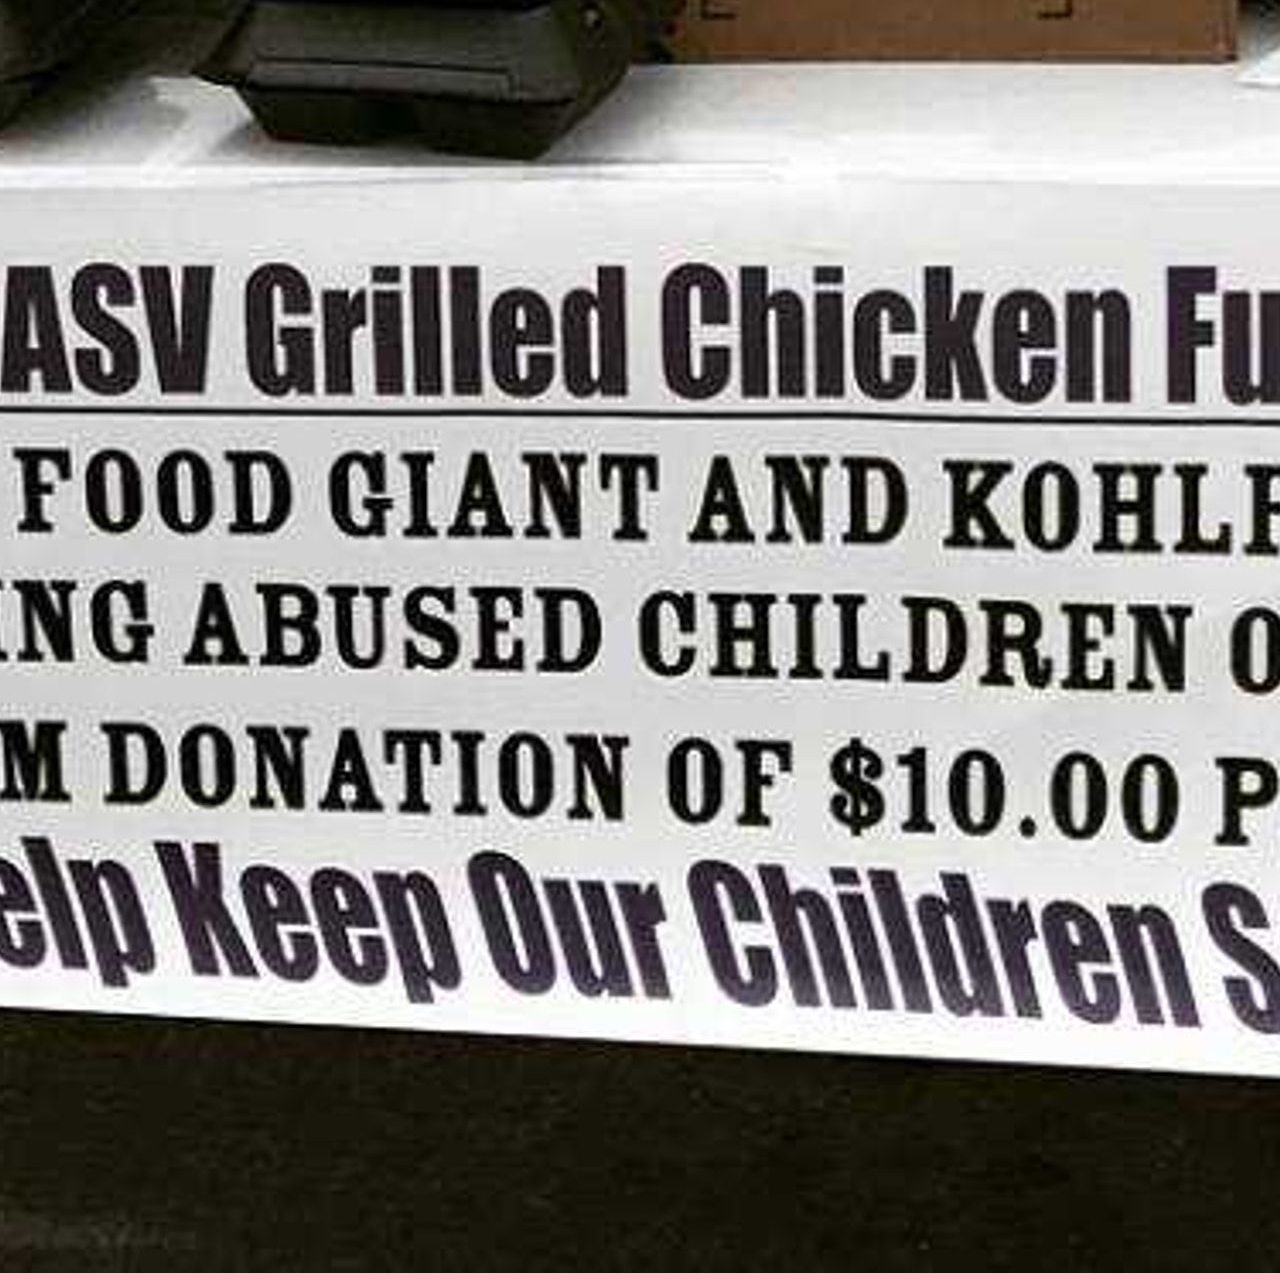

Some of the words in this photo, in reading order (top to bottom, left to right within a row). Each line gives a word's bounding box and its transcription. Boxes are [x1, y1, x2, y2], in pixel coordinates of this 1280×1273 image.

[244, 262, 629, 399] Grilled
[661, 262, 1132, 405] Chicken
[12, 447, 293, 536] FOOD
[328, 450, 659, 542] GIANT
[687, 454, 909, 545] AND
[182, 582, 602, 673] ABUSED
[638, 590, 1194, 693] CHILDREN
[99, 721, 630, 822] DONATION
[667, 736, 793, 827] OF
[829, 737, 1179, 843] $10.00
[153, 840, 462, 1004] Keep
[467, 850, 671, 999] Our
[687, 859, 1200, 1027] Children
